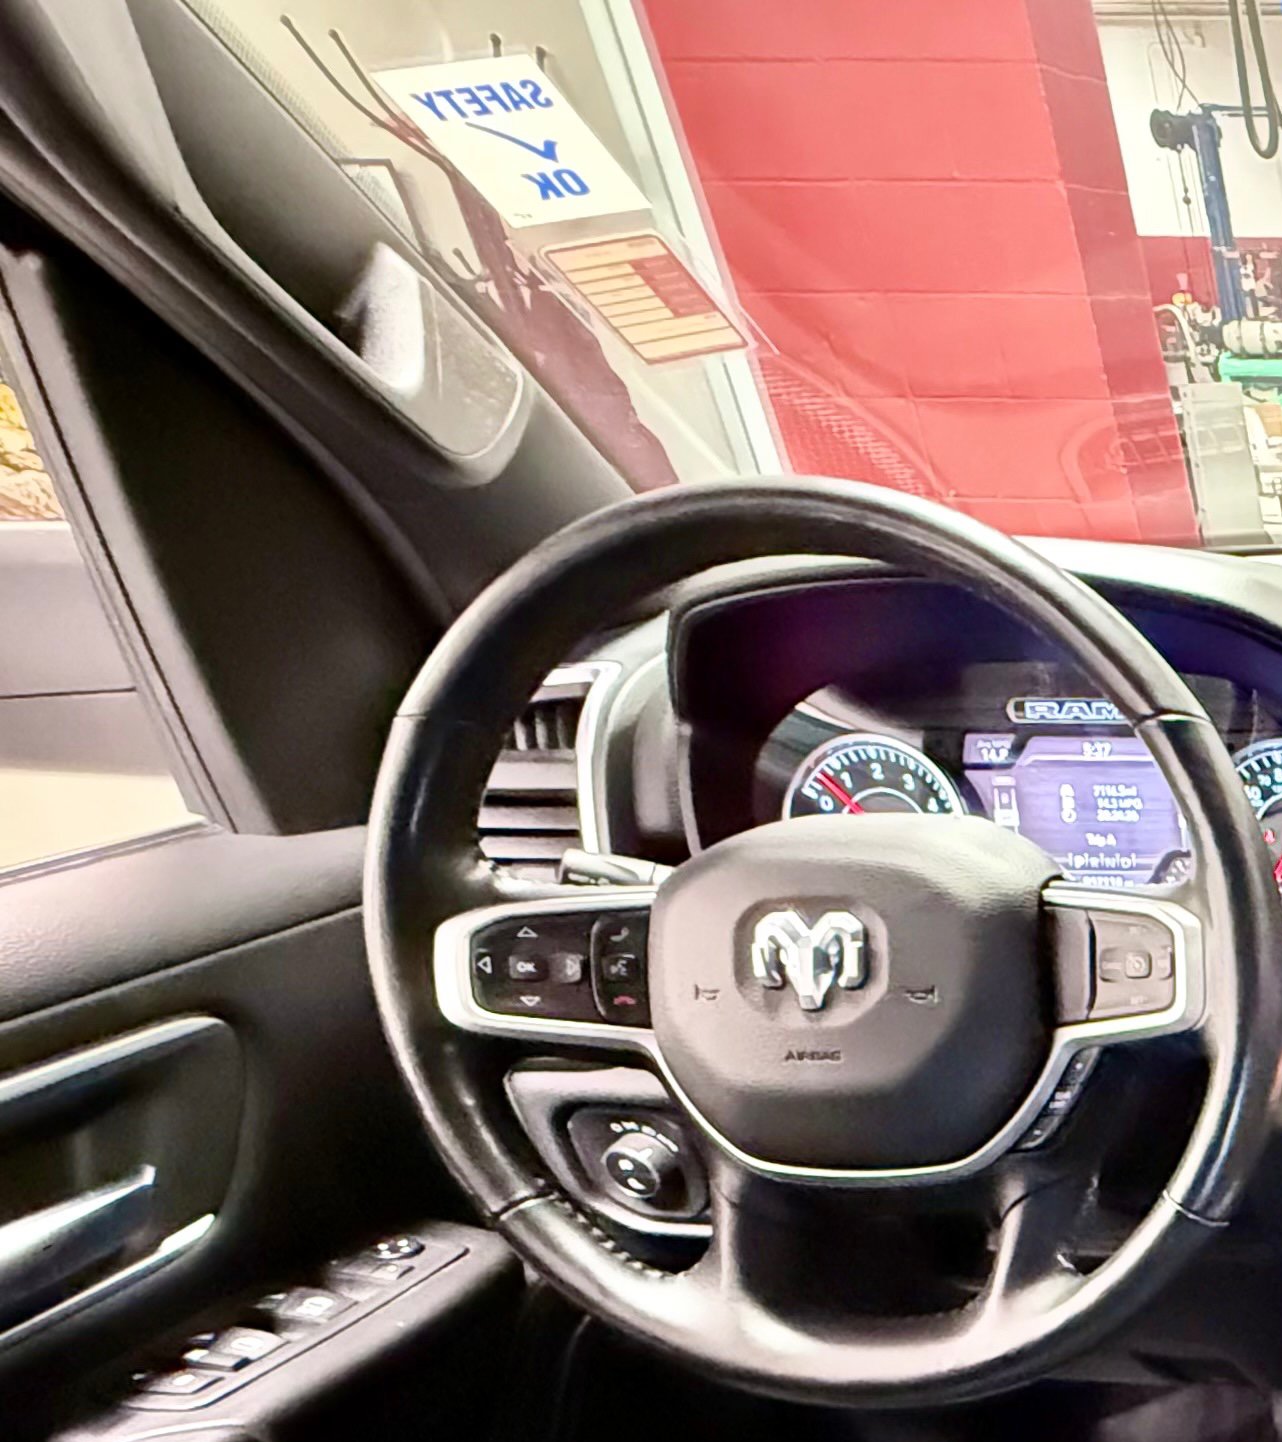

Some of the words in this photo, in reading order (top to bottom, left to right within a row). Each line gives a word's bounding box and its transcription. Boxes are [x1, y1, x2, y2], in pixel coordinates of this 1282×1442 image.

[1024, 701, 1127, 720] RAM
[840, 771, 853, 788] 1
[870, 763, 885, 780] 2
[902, 773, 915, 791] 3
[819, 794, 834, 811] 0
